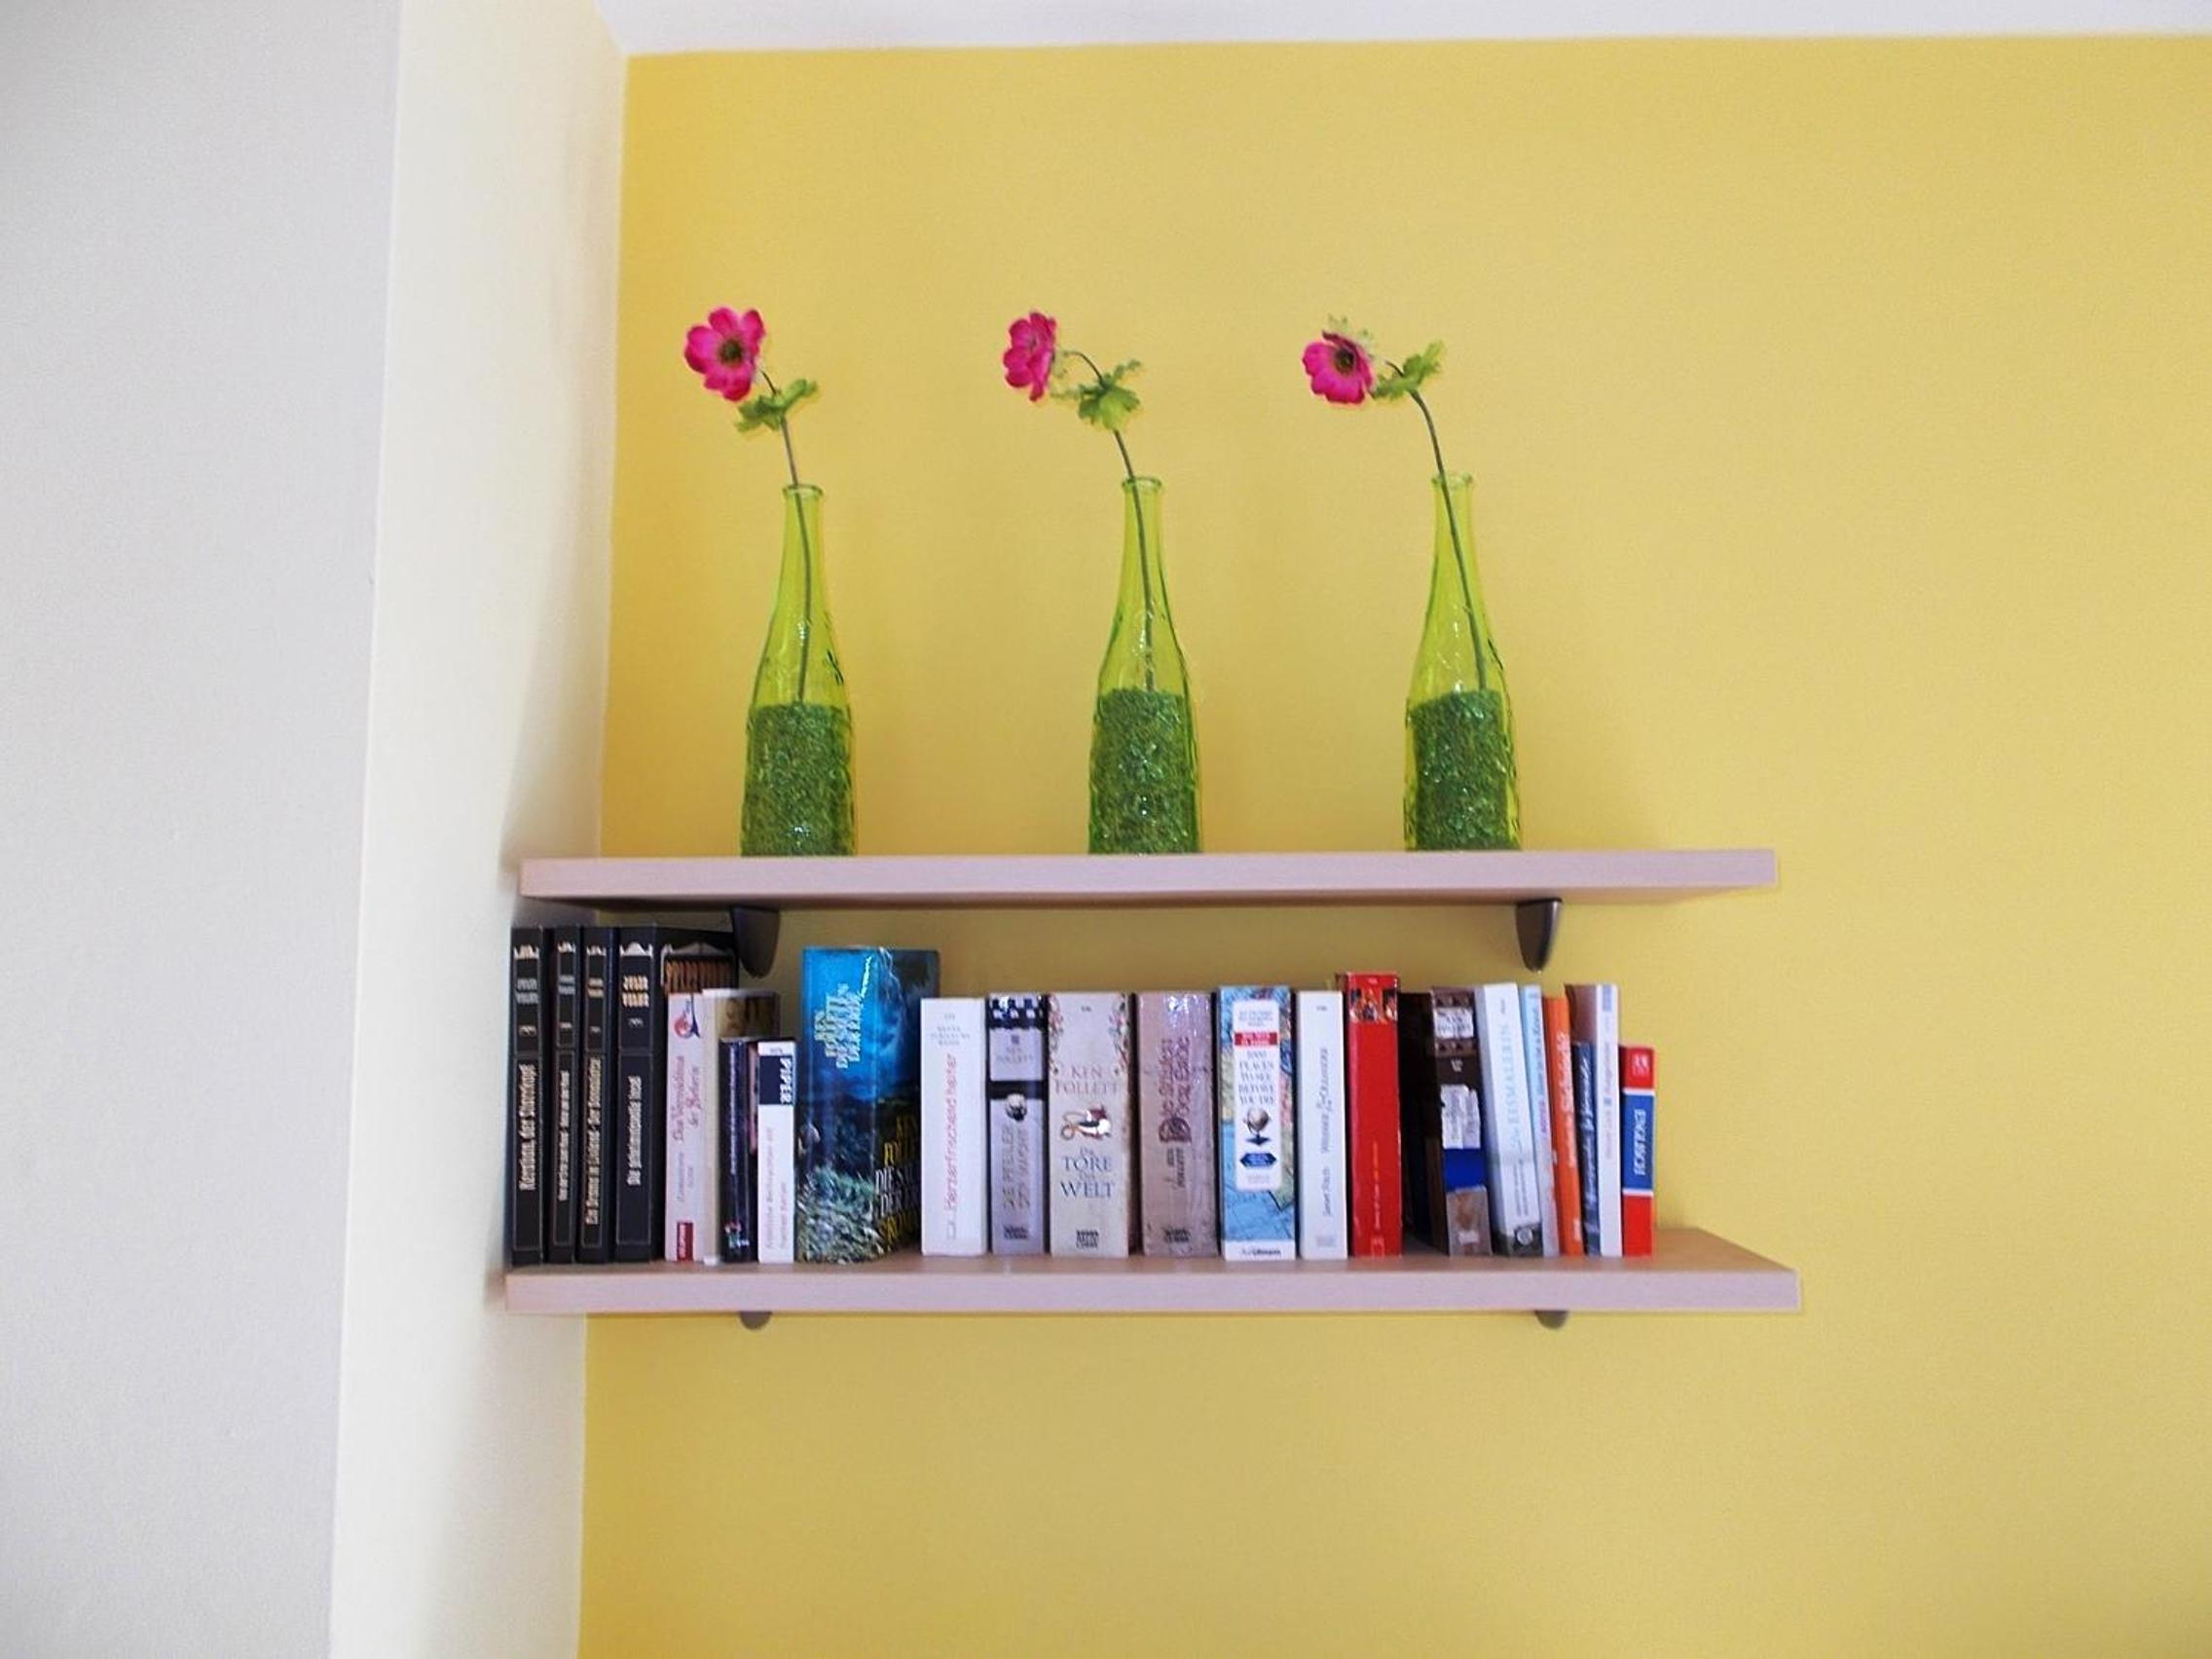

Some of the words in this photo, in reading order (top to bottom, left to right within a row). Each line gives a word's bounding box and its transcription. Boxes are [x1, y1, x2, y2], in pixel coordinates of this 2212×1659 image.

[1071, 1065, 1101, 1079] KEN
[780, 1057, 792, 1105] PIPER
[1055, 1080, 1119, 1094] FOLLETT
[1061, 1156, 1112, 1172] TORE
[1060, 1182, 1115, 1198] WELT
